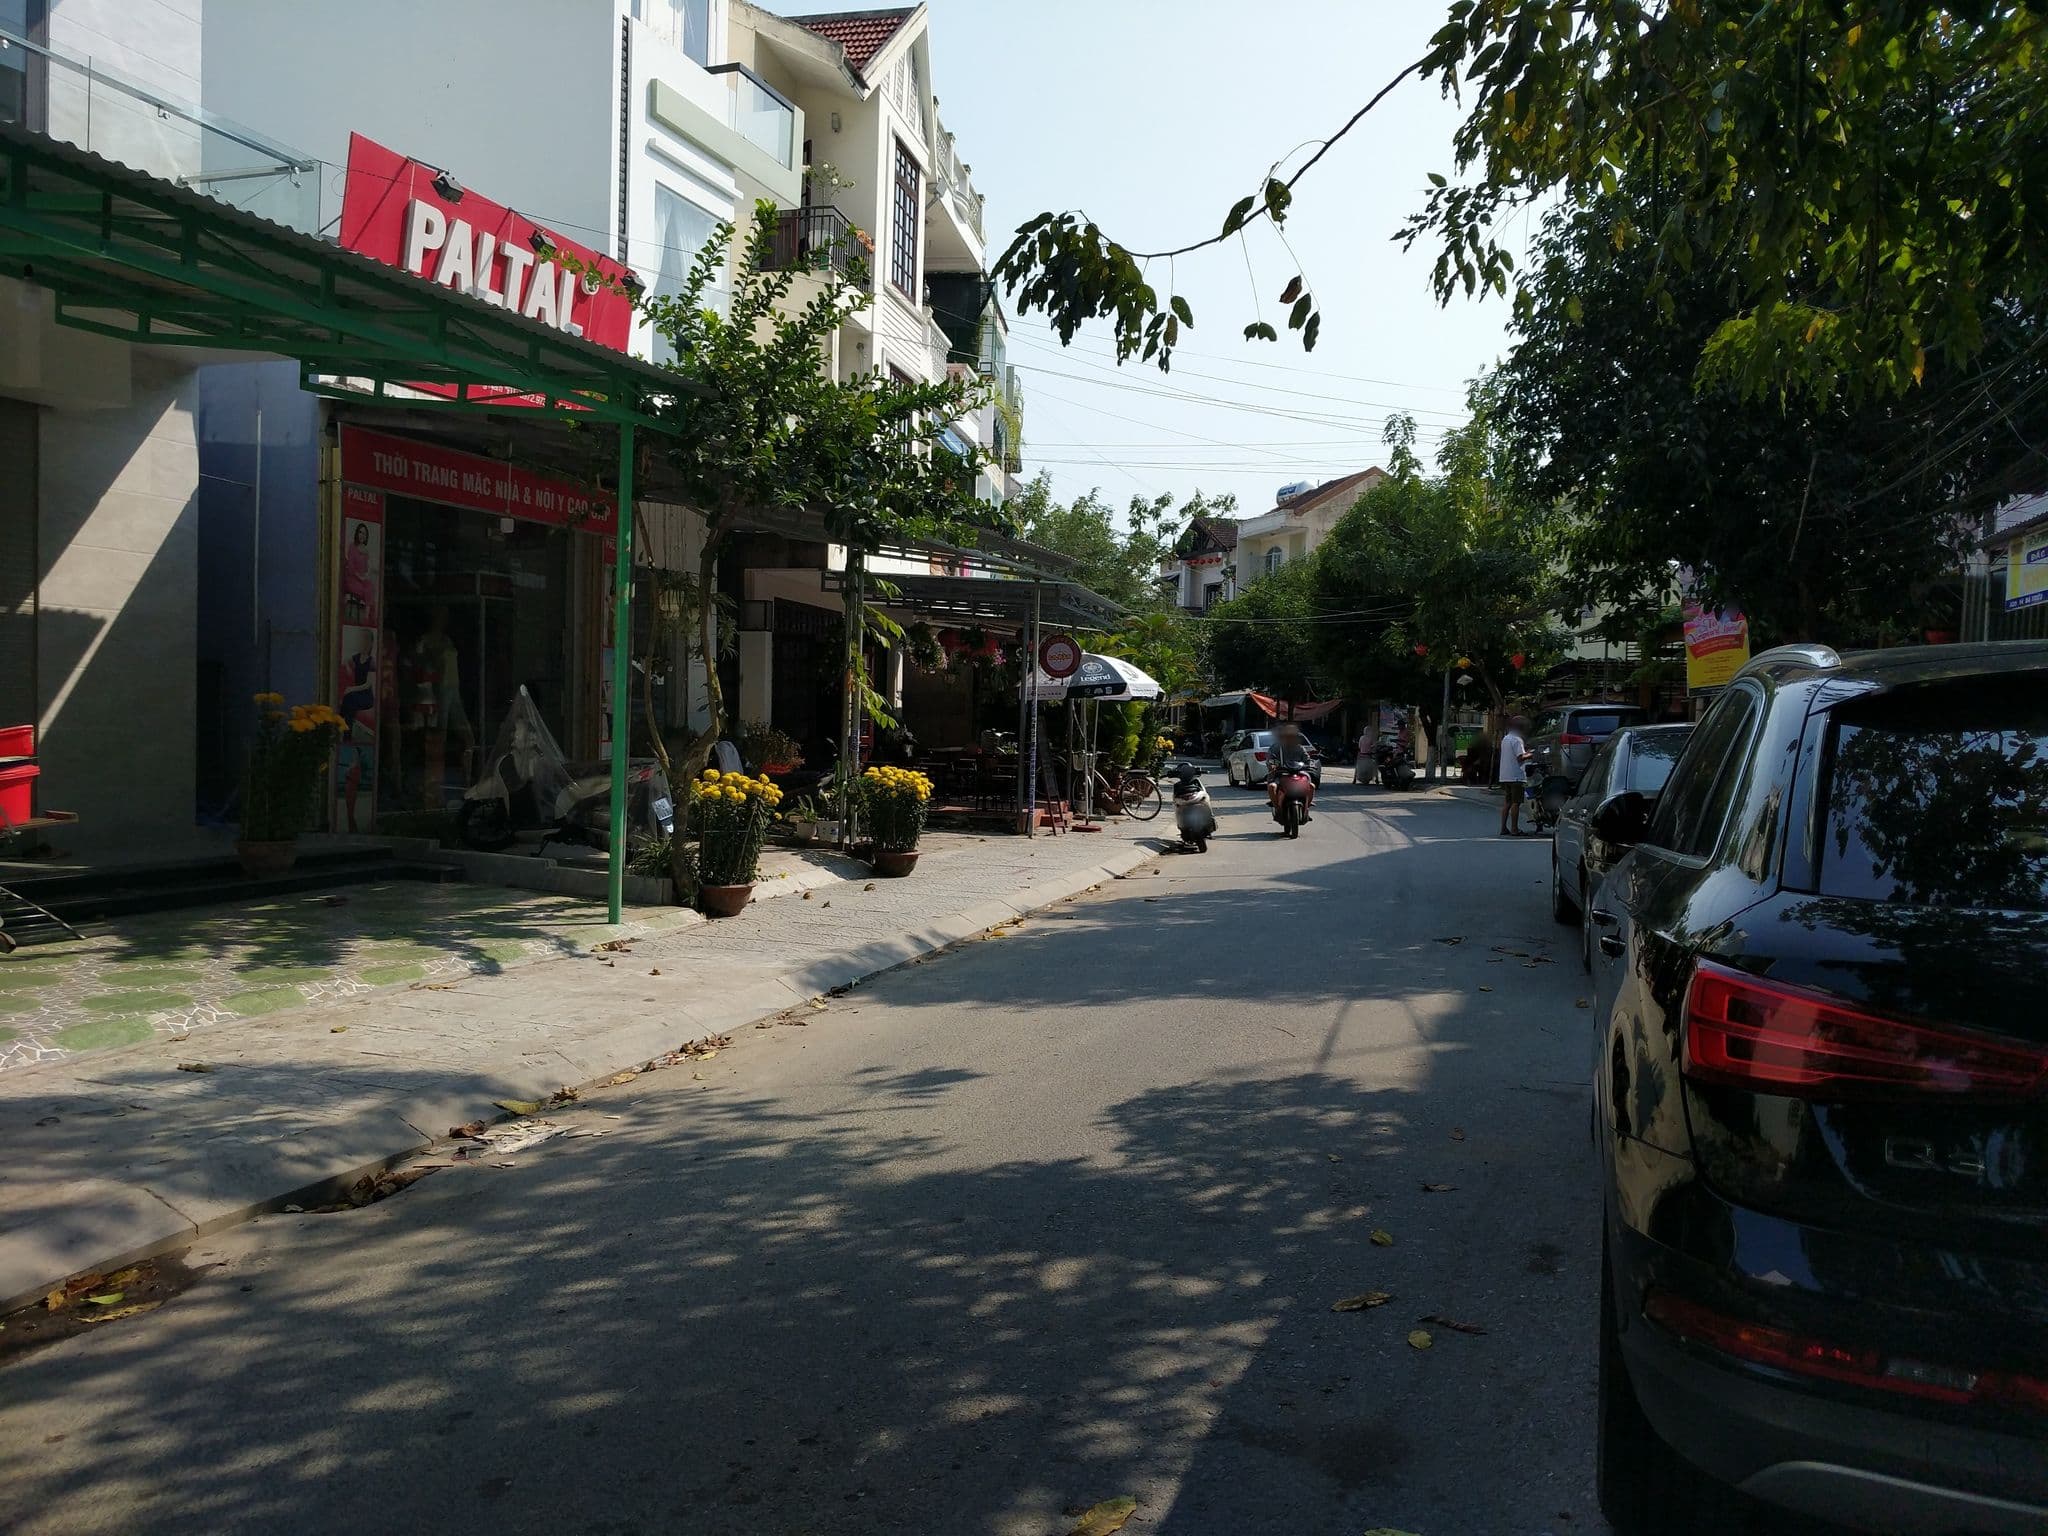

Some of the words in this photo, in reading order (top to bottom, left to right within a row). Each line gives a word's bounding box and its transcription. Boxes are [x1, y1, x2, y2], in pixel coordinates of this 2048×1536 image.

[402, 198, 584, 337] PALTAL
[348, 487, 378, 505] PALTAL
[413, 461, 458, 489] TRANG
[523, 486, 531, 505] &
[536, 488, 554, 512] NỘI
[558, 494, 565, 512] Y
[567, 497, 588, 515] CAO
